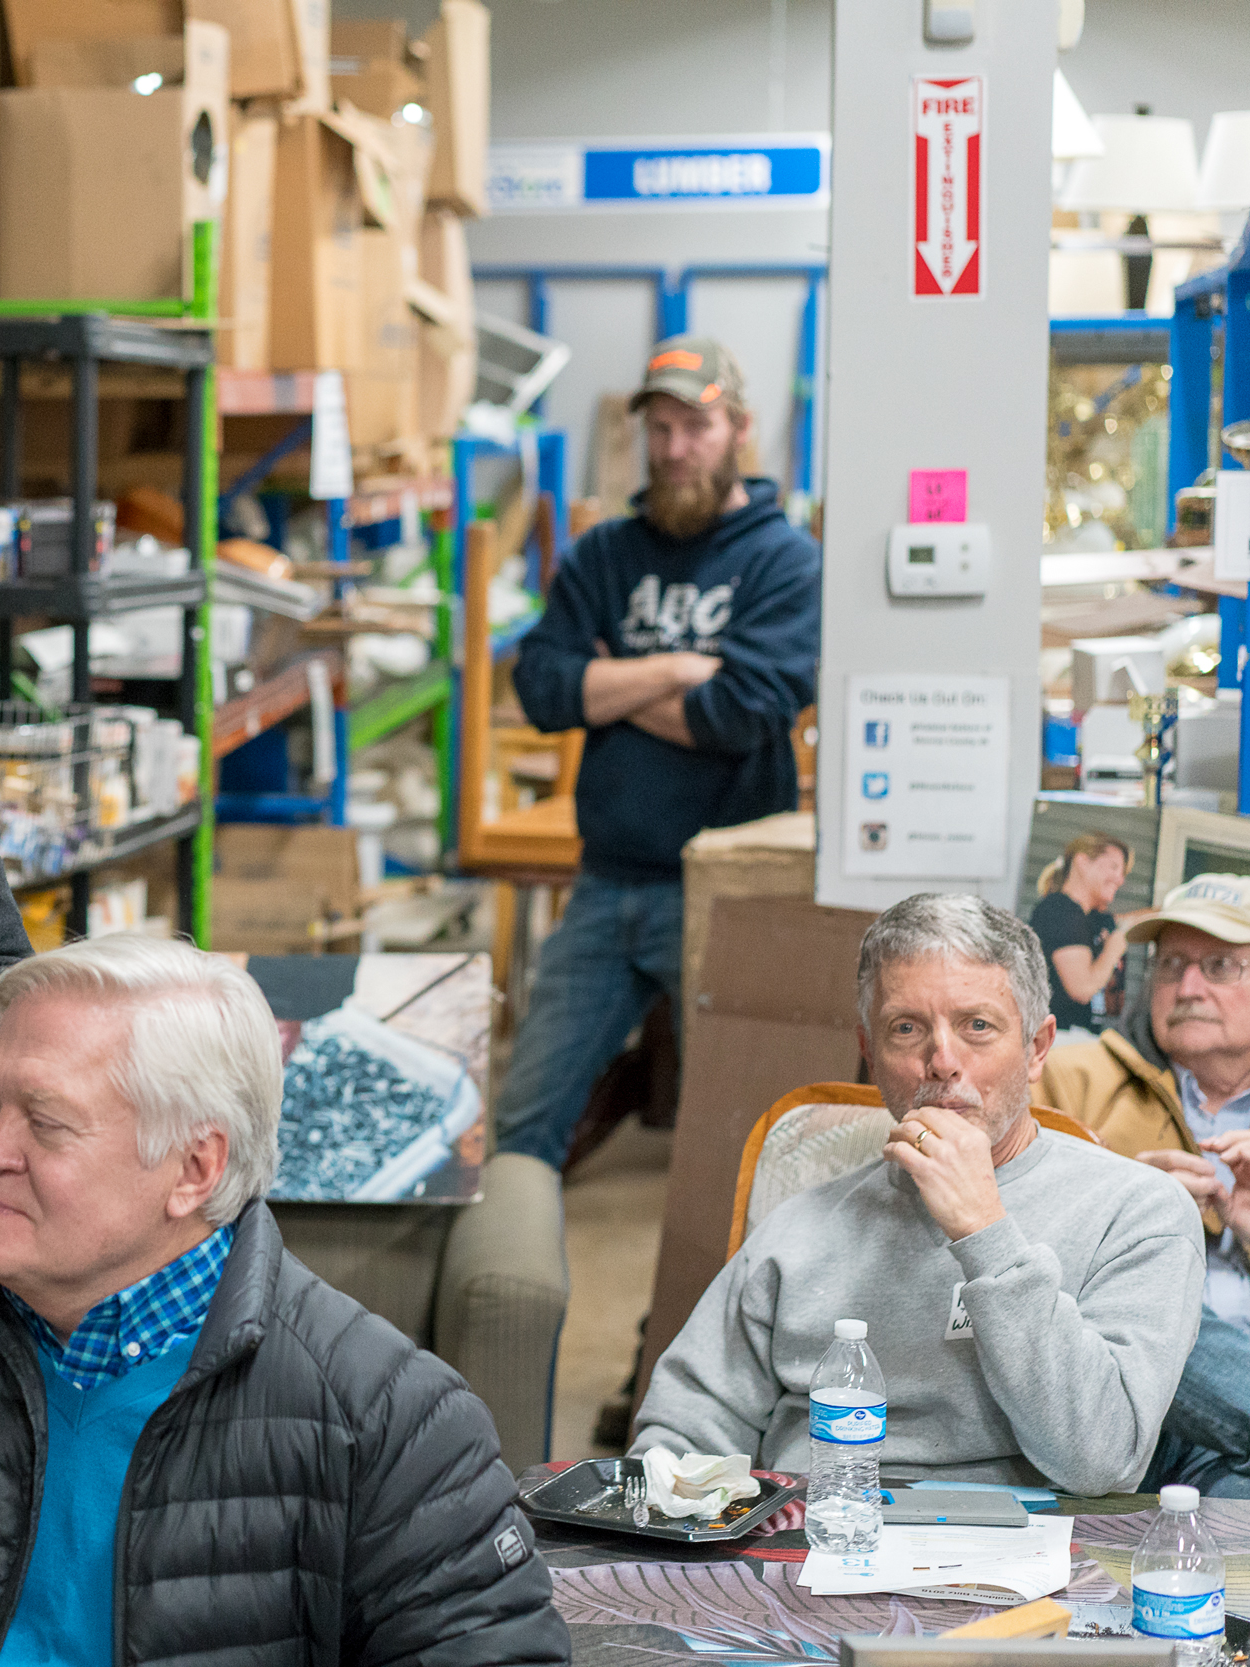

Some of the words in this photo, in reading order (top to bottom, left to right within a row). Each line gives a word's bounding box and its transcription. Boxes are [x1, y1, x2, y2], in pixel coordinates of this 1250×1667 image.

[922, 97, 974, 115] FIRE
[942, 122, 954, 278] EXTINGUISHER
[842, 1558, 876, 1567] 13
